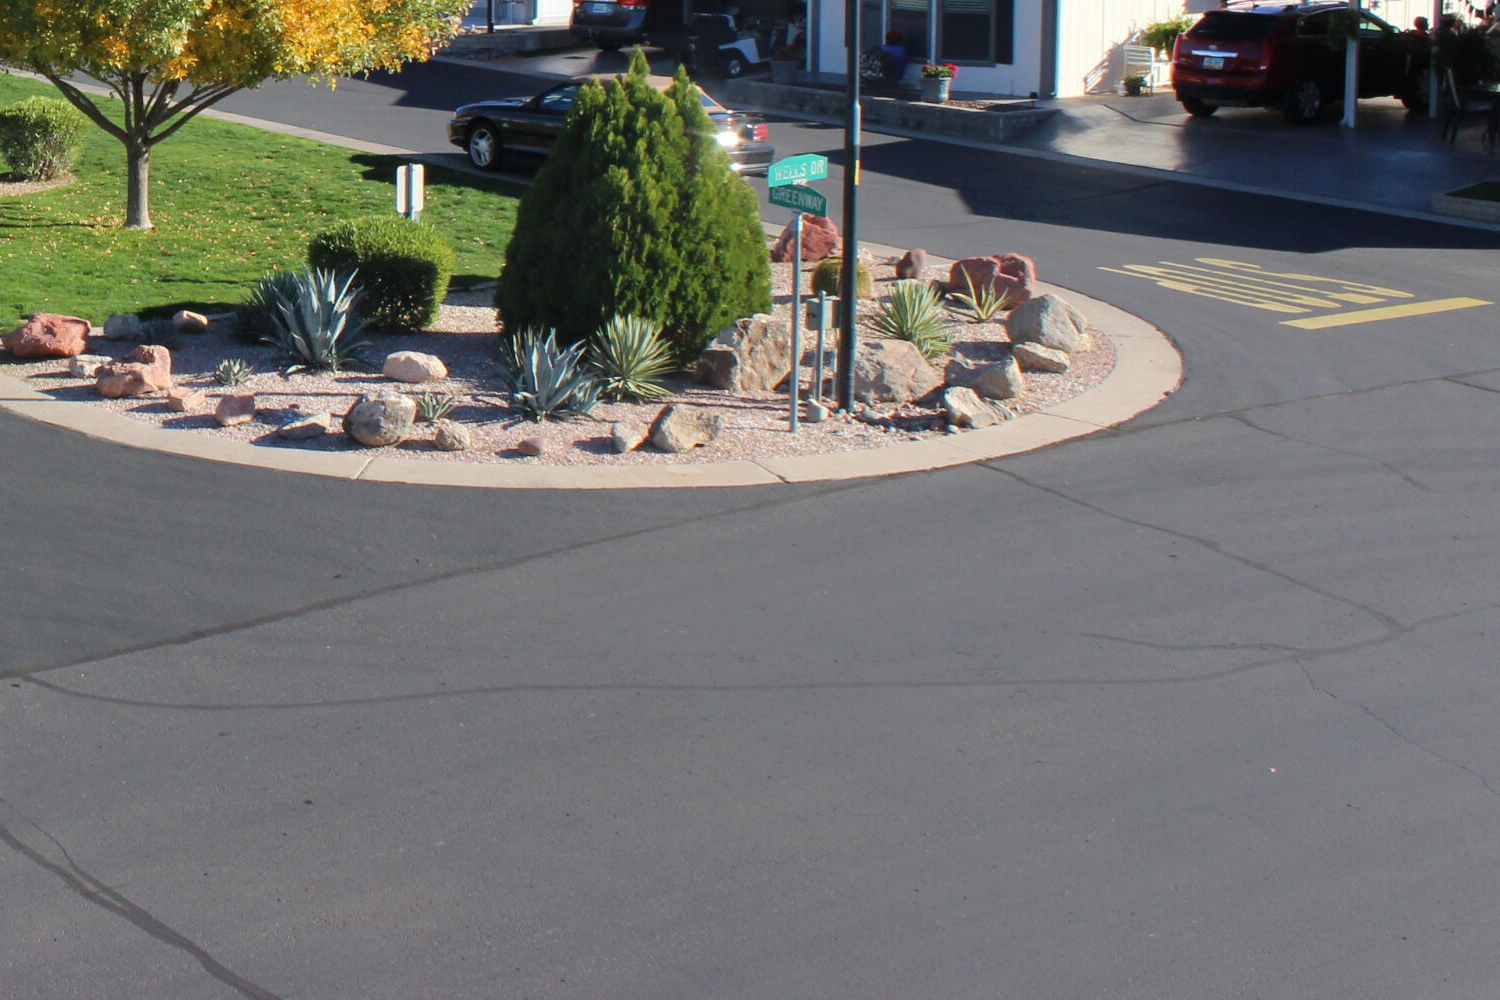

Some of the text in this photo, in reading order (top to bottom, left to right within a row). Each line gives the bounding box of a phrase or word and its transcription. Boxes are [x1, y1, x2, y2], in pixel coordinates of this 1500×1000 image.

[774, 159, 825, 181] WELLS DR
[773, 188, 824, 212] GREENWAY
